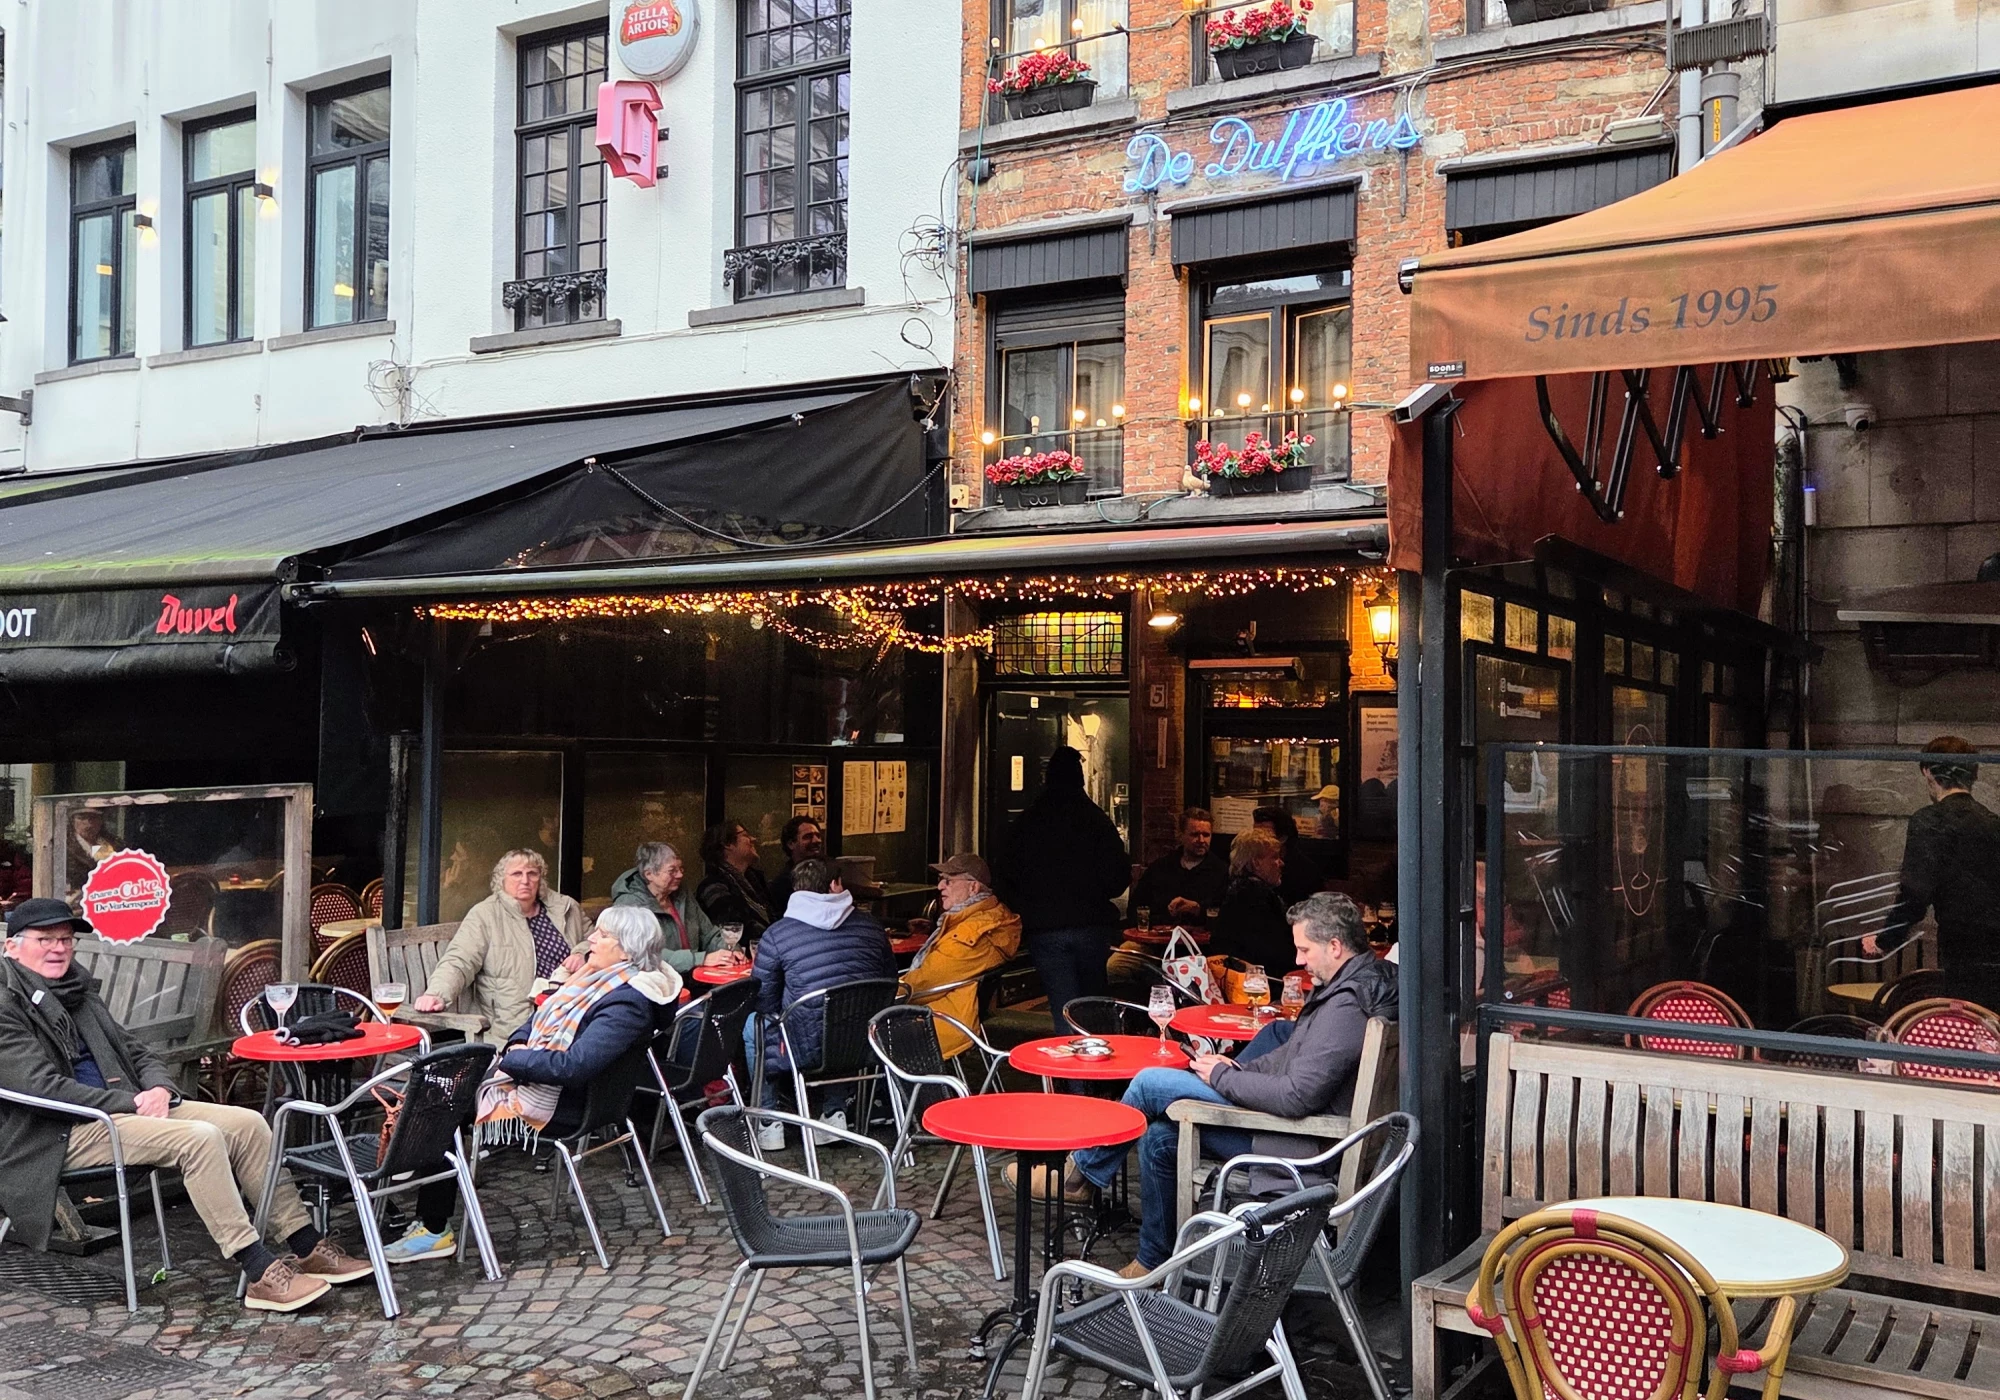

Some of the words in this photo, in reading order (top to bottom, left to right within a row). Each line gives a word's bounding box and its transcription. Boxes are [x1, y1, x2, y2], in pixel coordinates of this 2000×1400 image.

[628, 6, 668, 24] STELLA
[628, 18, 669, 36] ARTOIS
[1123, 131, 1194, 192] De
[1525, 296, 1650, 342] Sinds
[1670, 284, 1779, 330] 1995
[155, 593, 238, 635] Duvel
[1152, 685, 1163, 704] 5
[90, 890, 113, 899] share
[119, 879, 159, 898] Coke
[95, 903, 108, 911] De
